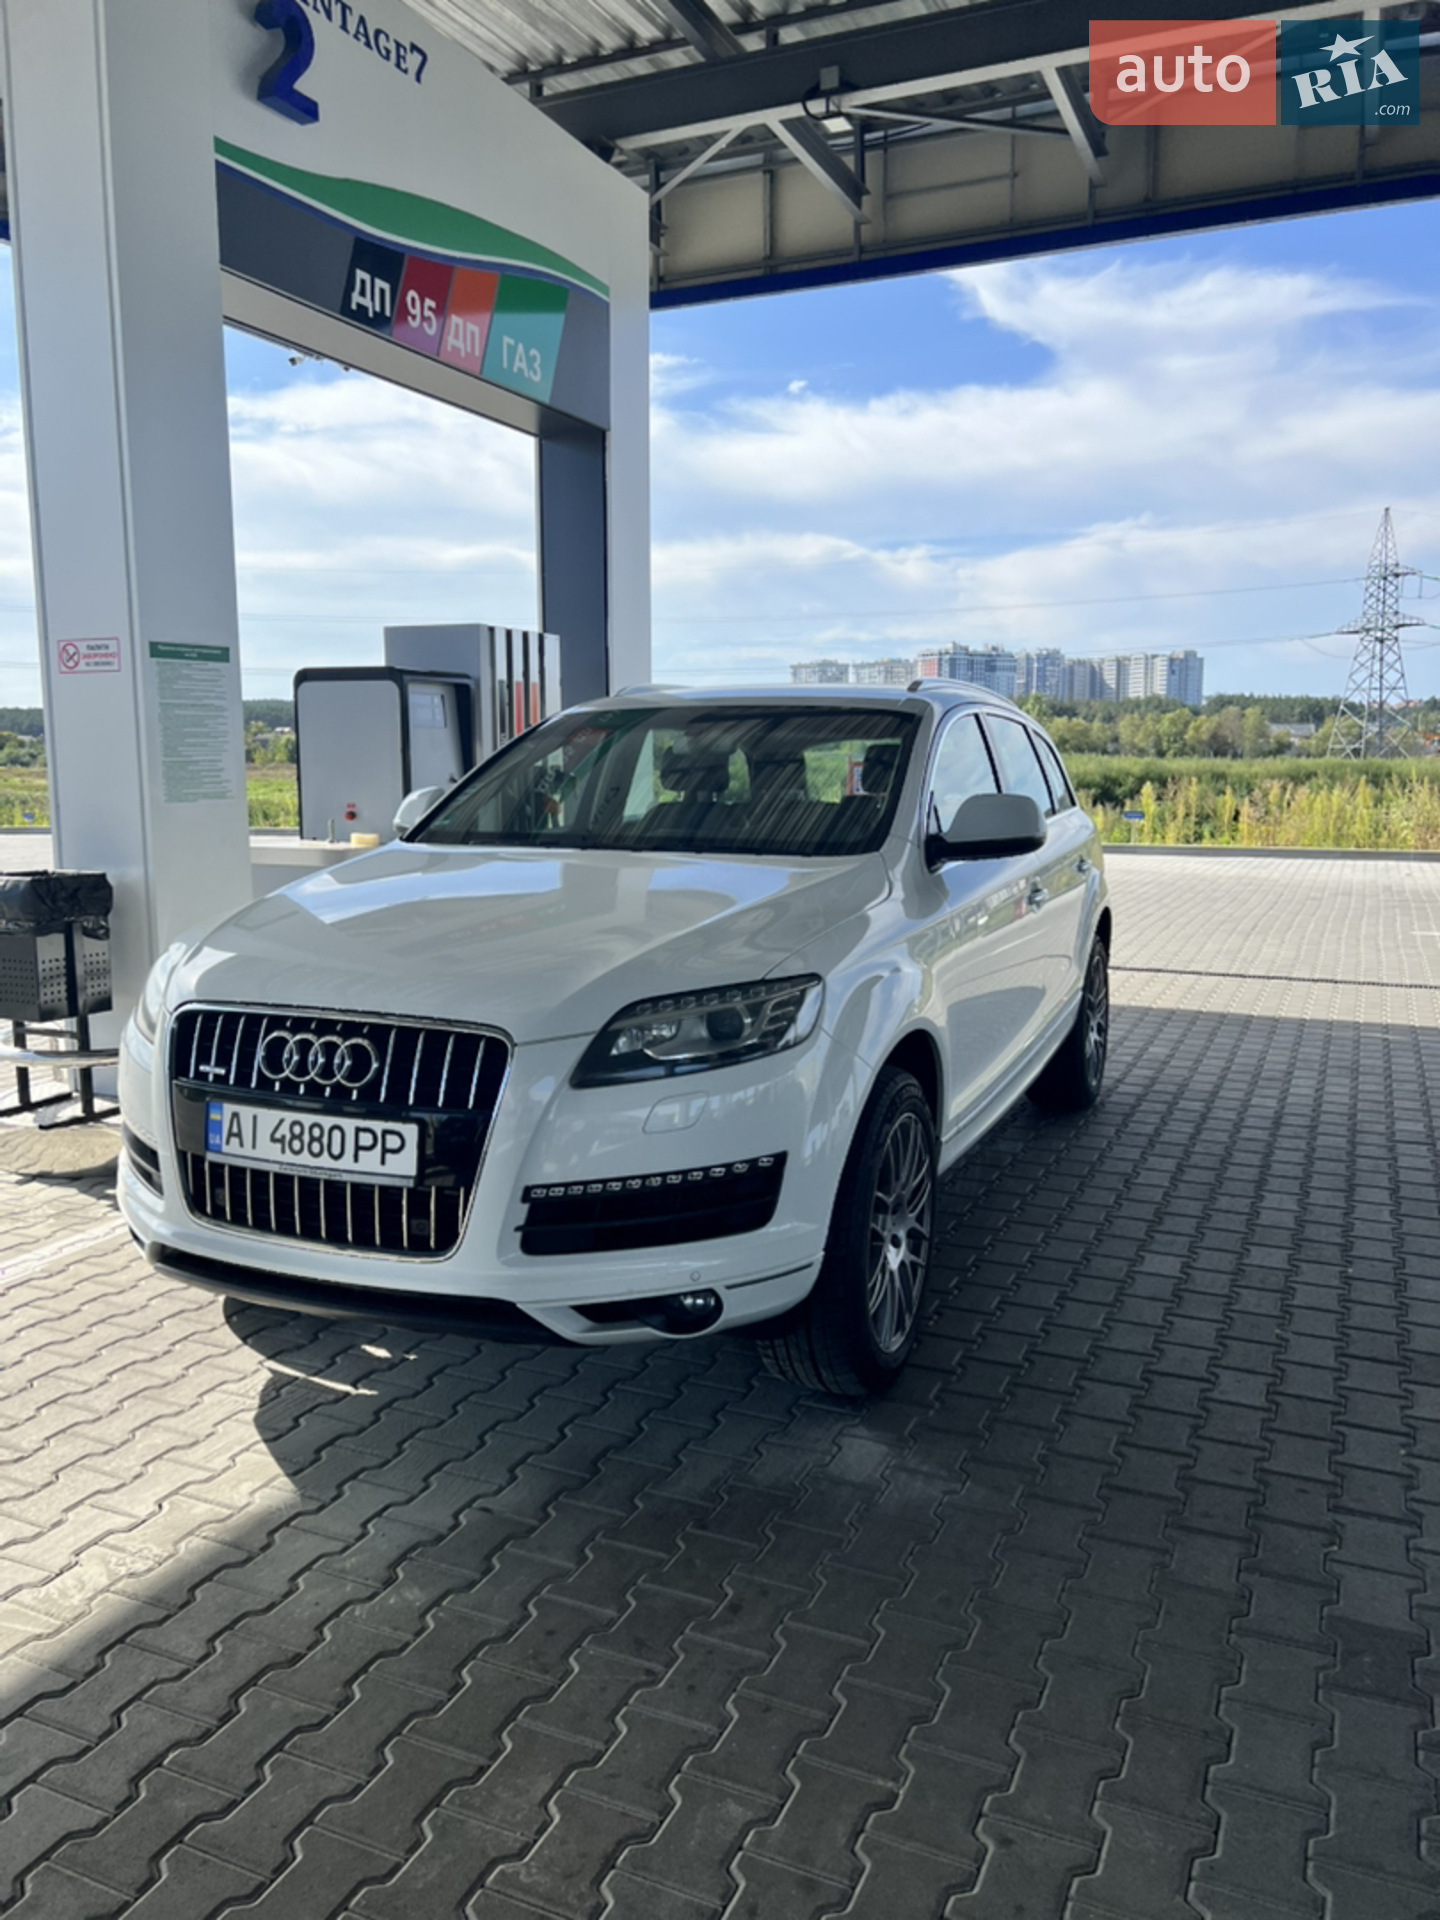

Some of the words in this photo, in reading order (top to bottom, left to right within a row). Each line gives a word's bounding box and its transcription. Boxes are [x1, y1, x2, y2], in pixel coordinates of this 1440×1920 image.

[254, 0, 319, 125] 2
[301, 0, 428, 84] NTAGE7
[351, 268, 391, 318] ДП
[405, 289, 437, 336] 95
[447, 314, 481, 358] ДП
[502, 335, 542, 383] ГАЗ
